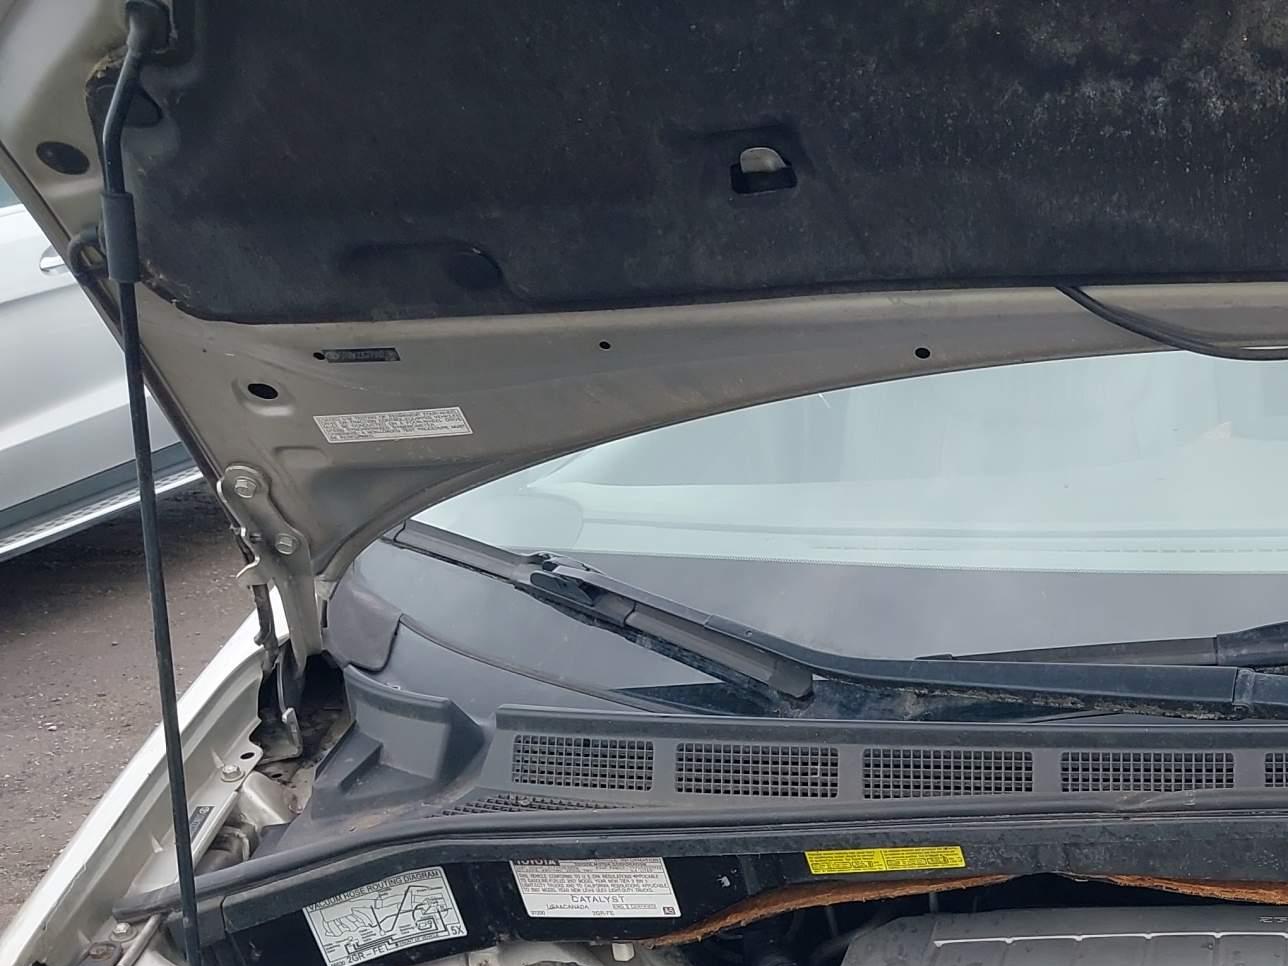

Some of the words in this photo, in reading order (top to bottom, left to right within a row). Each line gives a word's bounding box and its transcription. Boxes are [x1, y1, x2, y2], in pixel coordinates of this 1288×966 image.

[343, 884, 368, 900] HOSE
[367, 877, 403, 892] ROUTING
[403, 870, 440, 883] DIAGRAM
[571, 895, 625, 903] CATALYST
[451, 925, 464, 936] 5X
